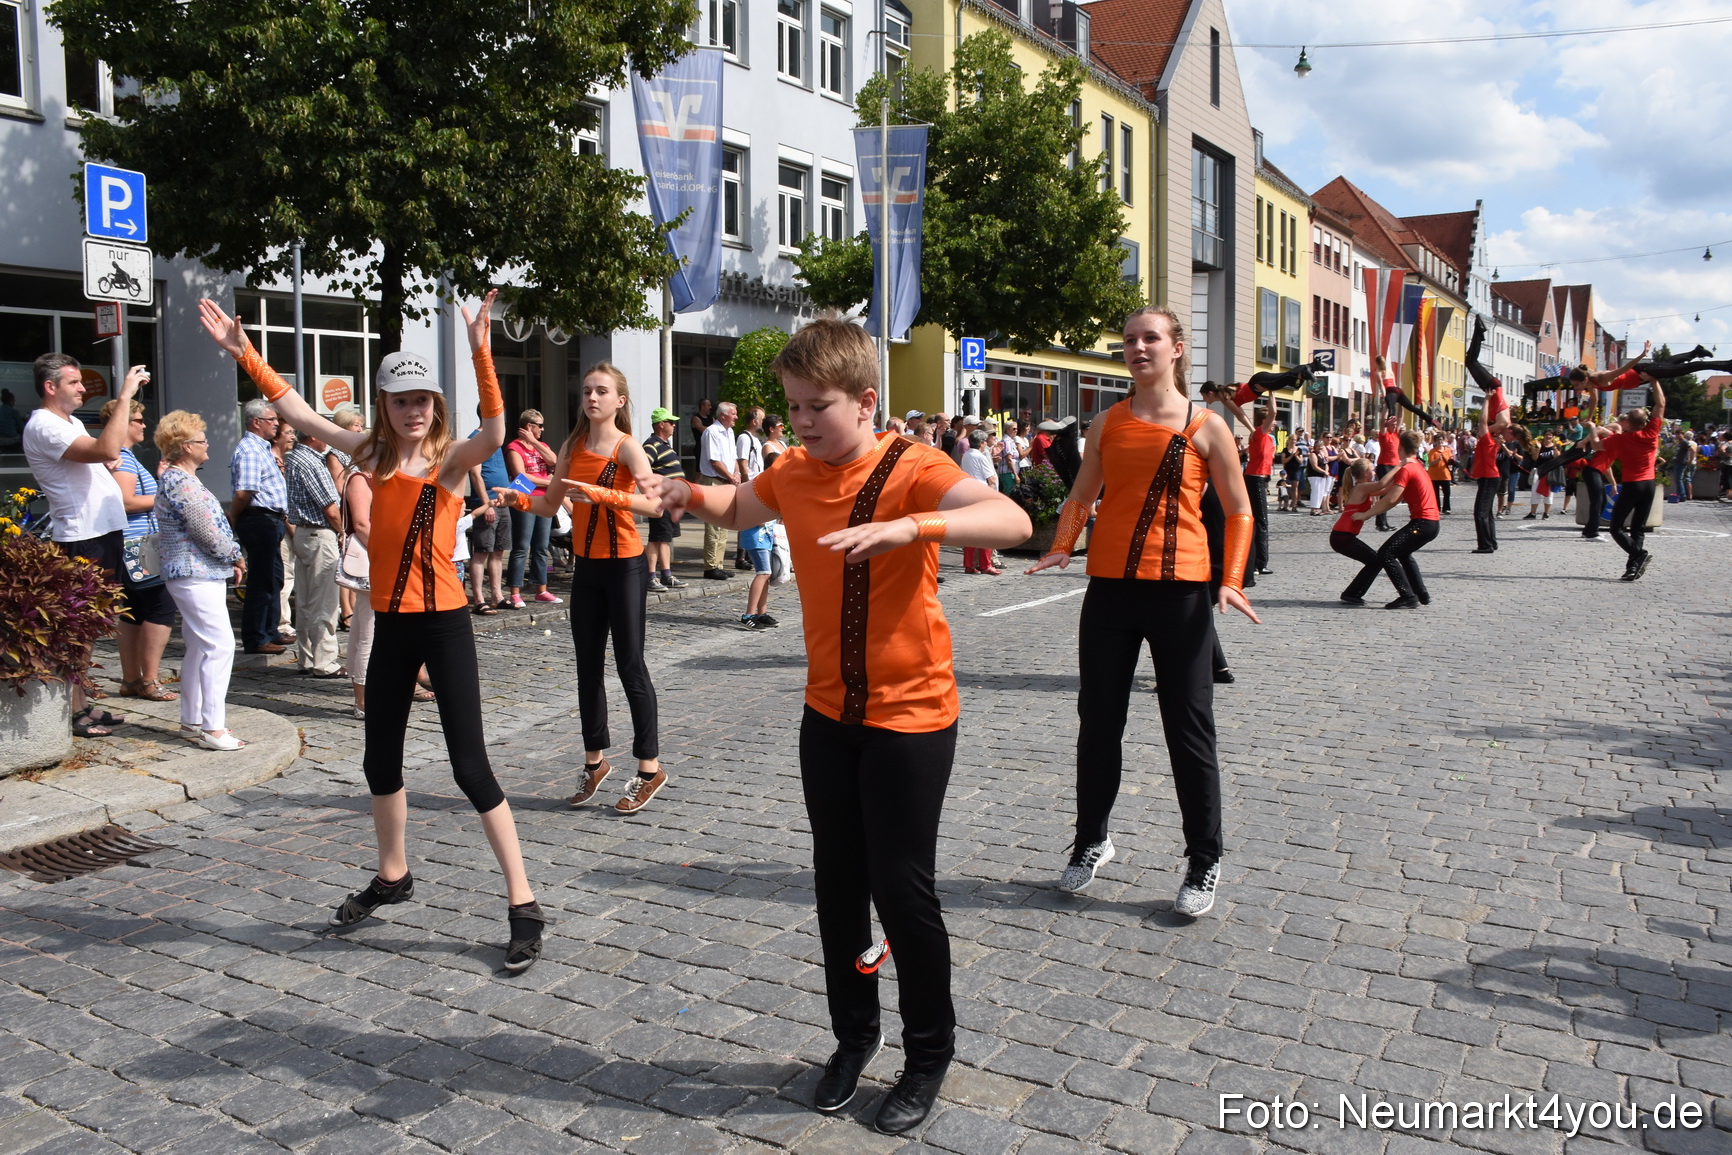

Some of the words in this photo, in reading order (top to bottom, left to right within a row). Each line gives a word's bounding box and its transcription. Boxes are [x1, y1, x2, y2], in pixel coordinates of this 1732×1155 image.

[101, 175, 133, 228] P
[108, 249, 130, 262] nur
[966, 342, 980, 366] P
